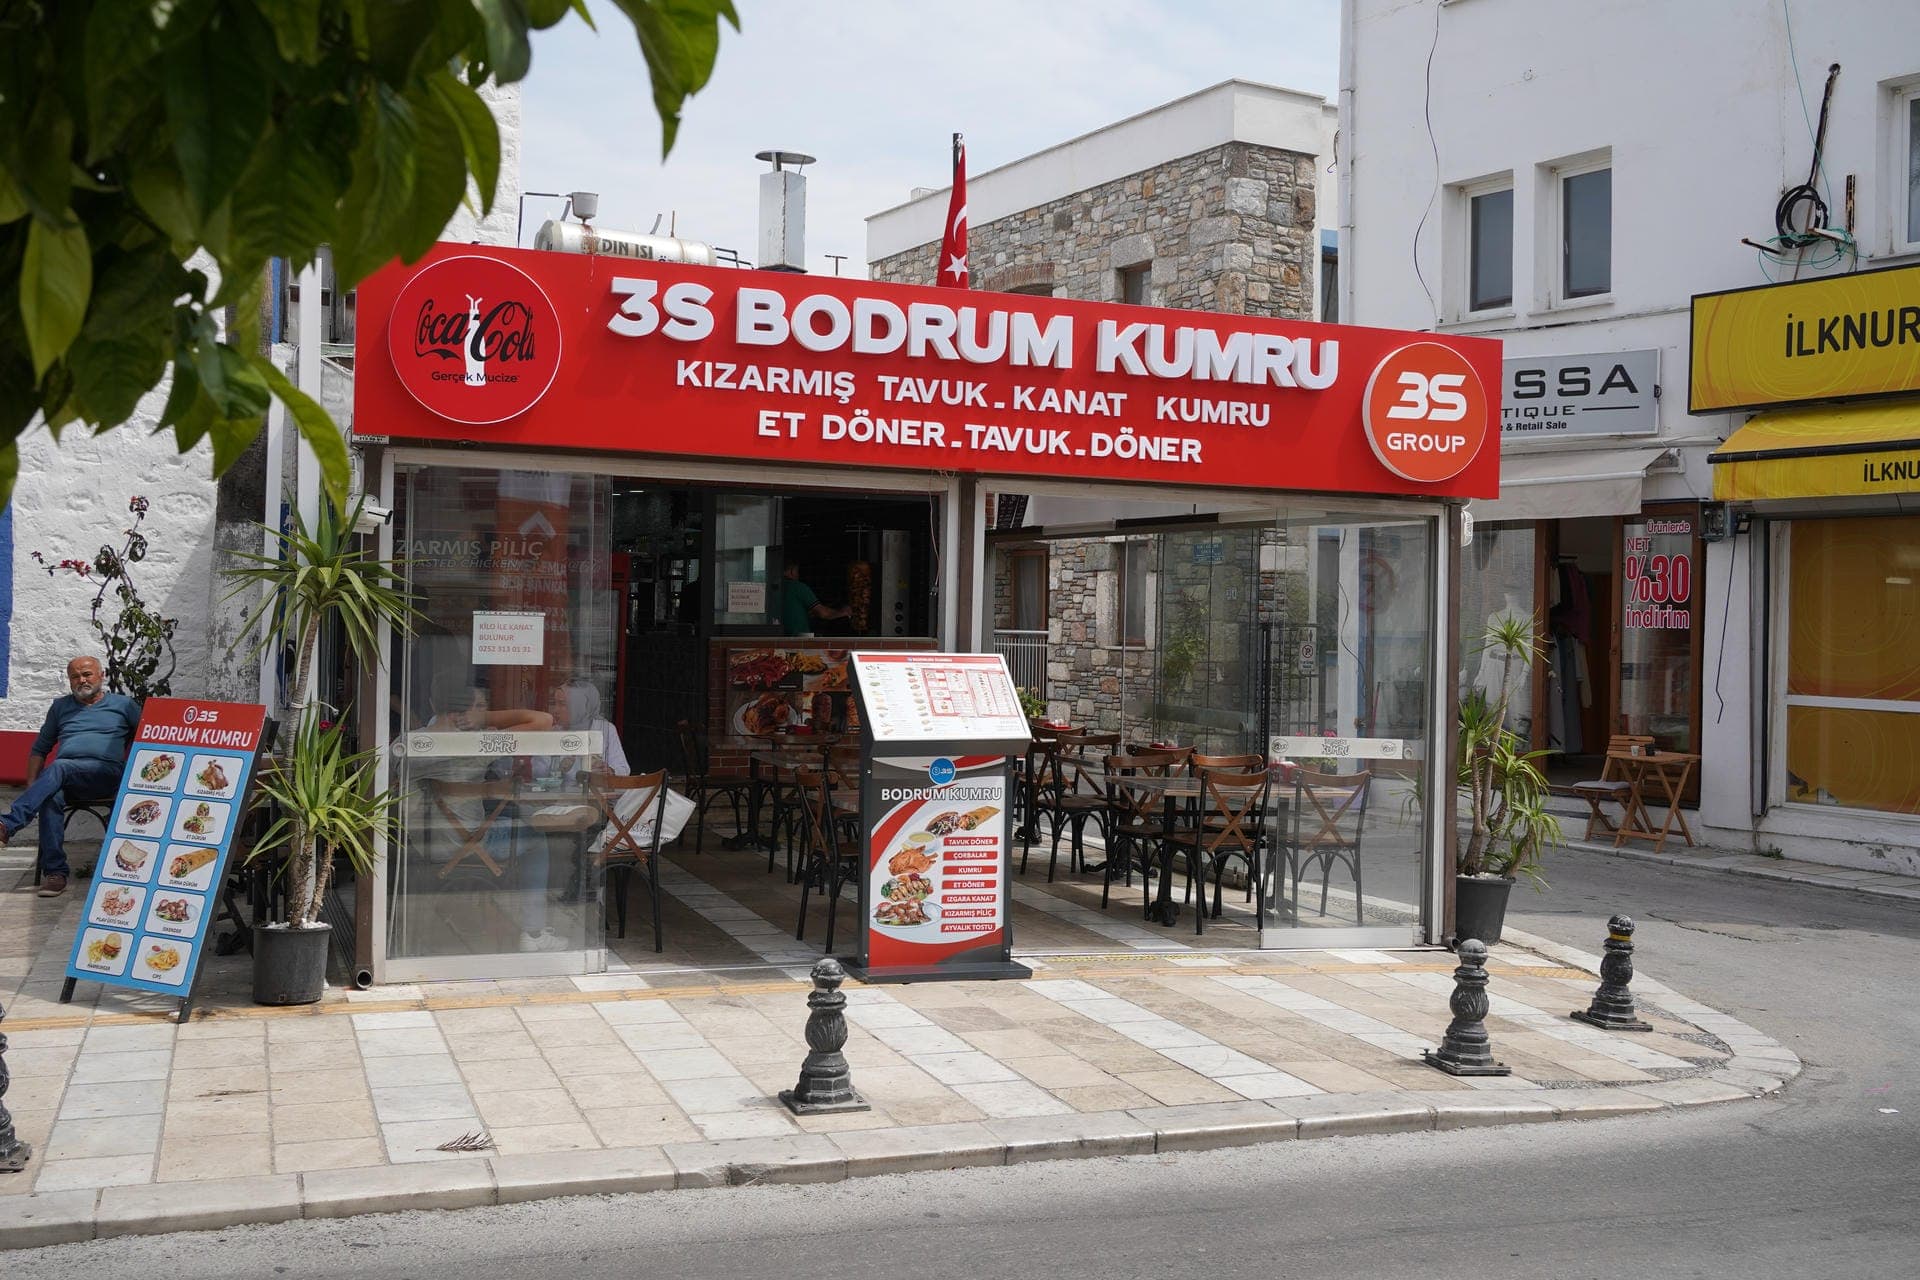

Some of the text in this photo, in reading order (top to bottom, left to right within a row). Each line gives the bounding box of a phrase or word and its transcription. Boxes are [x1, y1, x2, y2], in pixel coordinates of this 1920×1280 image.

[607, 277, 1340, 390] 3S BODRUM KUMRU
[1785, 306, 1920, 358] İLKNUR
[431, 371, 518, 383] Gerçek Mucize
[1513, 364, 1639, 399] SSA
[386, 371, 467, 421] 3S
[676, 360, 855, 404] KIZARMIŞ
[1156, 396, 1270, 427] KUMRU
[1502, 405, 1576, 419] TIQUE
[758, 411, 806, 438] ET
[1506, 423, 1513, 431] &
[1516, 422, 1543, 431] Retail
[1546, 421, 1567, 430] Sale
[386, 432, 466, 453] GROUP
[1647, 519, 1691, 534] Ürünlerde
[490, 537, 544, 560] PİLİÇ
[1626, 536, 1650, 552] NET
[1625, 554, 1691, 603] %30
[1625, 604, 1690, 629] indirim
[141, 724, 253, 747] BODRUM KUMRU
[881, 788, 1001, 801] BODRUM KUMRU
[970, 837, 993, 845] DÖNER
[976, 909, 992, 917] PİLİÇ
